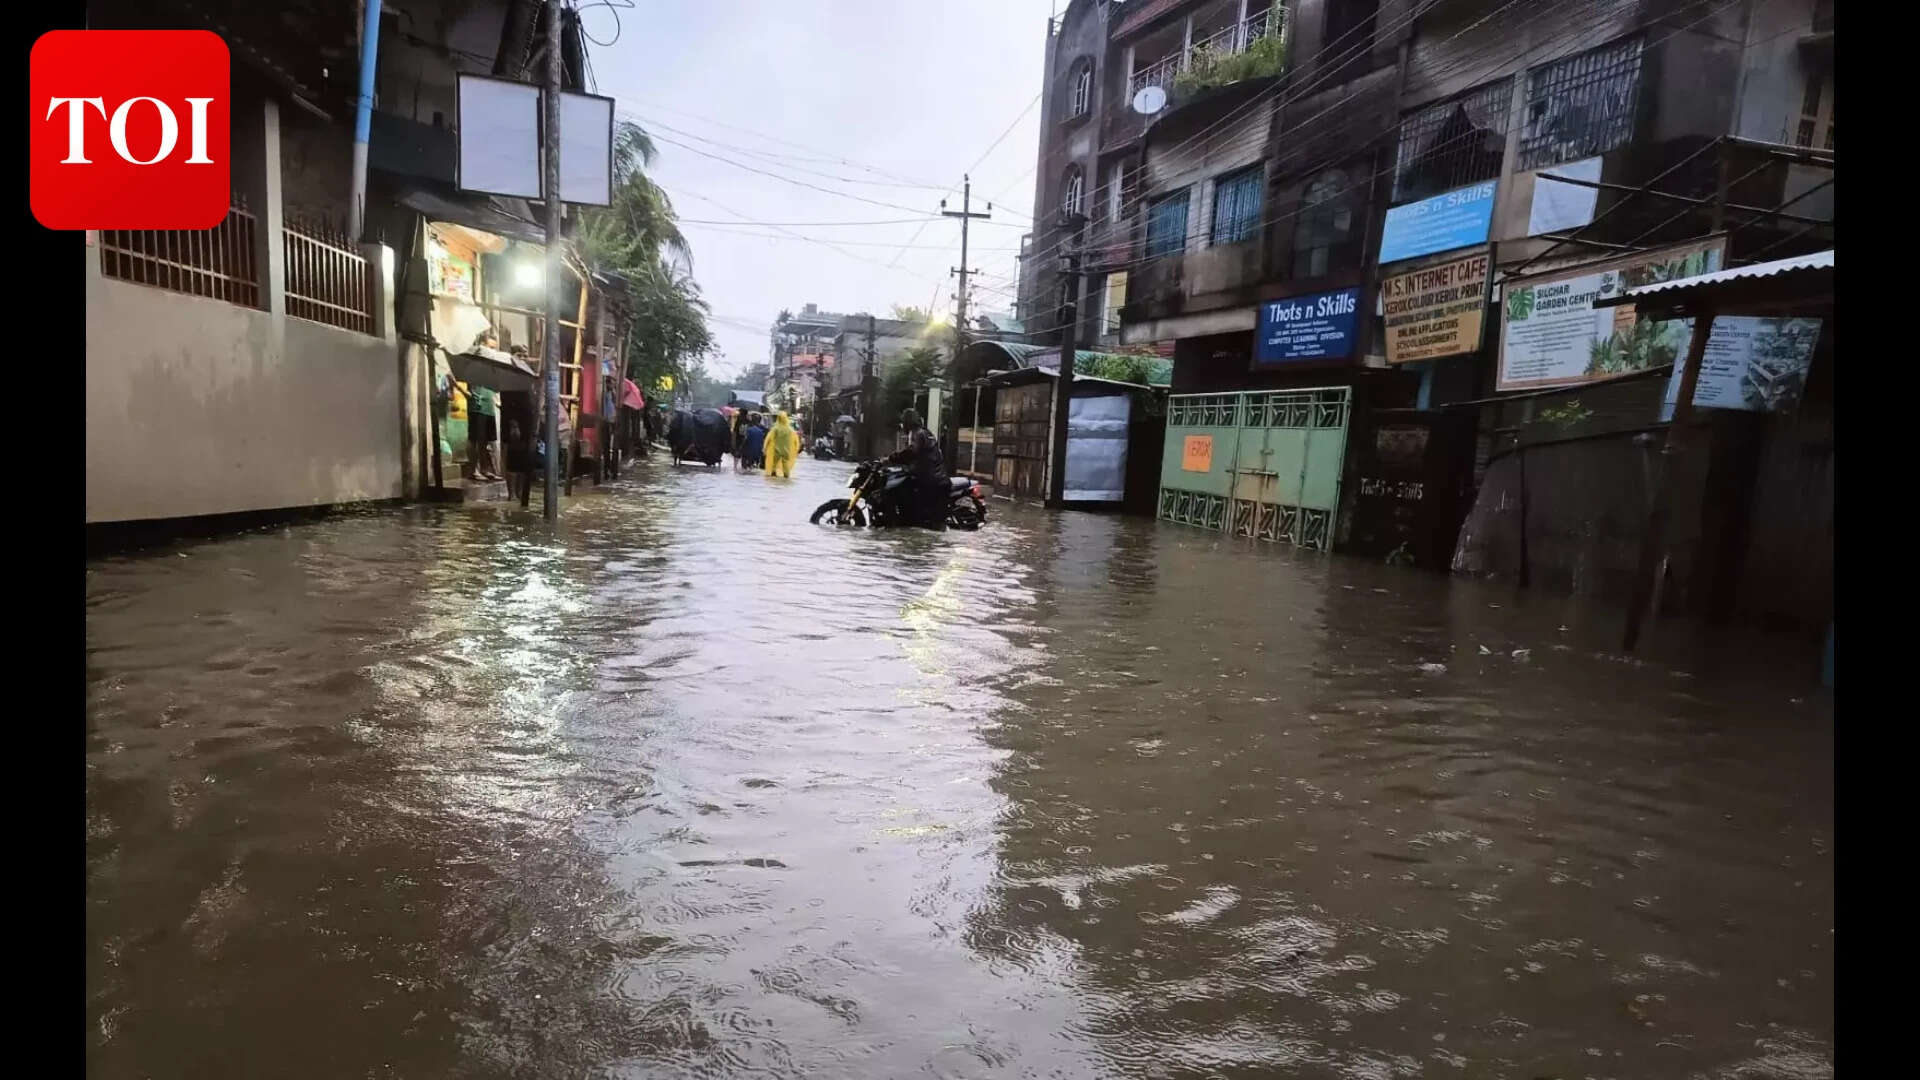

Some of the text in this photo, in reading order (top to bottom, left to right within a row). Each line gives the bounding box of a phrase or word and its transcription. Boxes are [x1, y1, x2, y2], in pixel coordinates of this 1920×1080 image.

[1405, 264, 1455, 294] INTERNET
[1457, 257, 1487, 281] CAFE
[1461, 281, 1484, 299] PRINT
[1536, 285, 1570, 300] SILCHAR
[1270, 293, 1356, 323] Thots n Skills
[1536, 291, 1601, 311] GARDEN CENTRE
